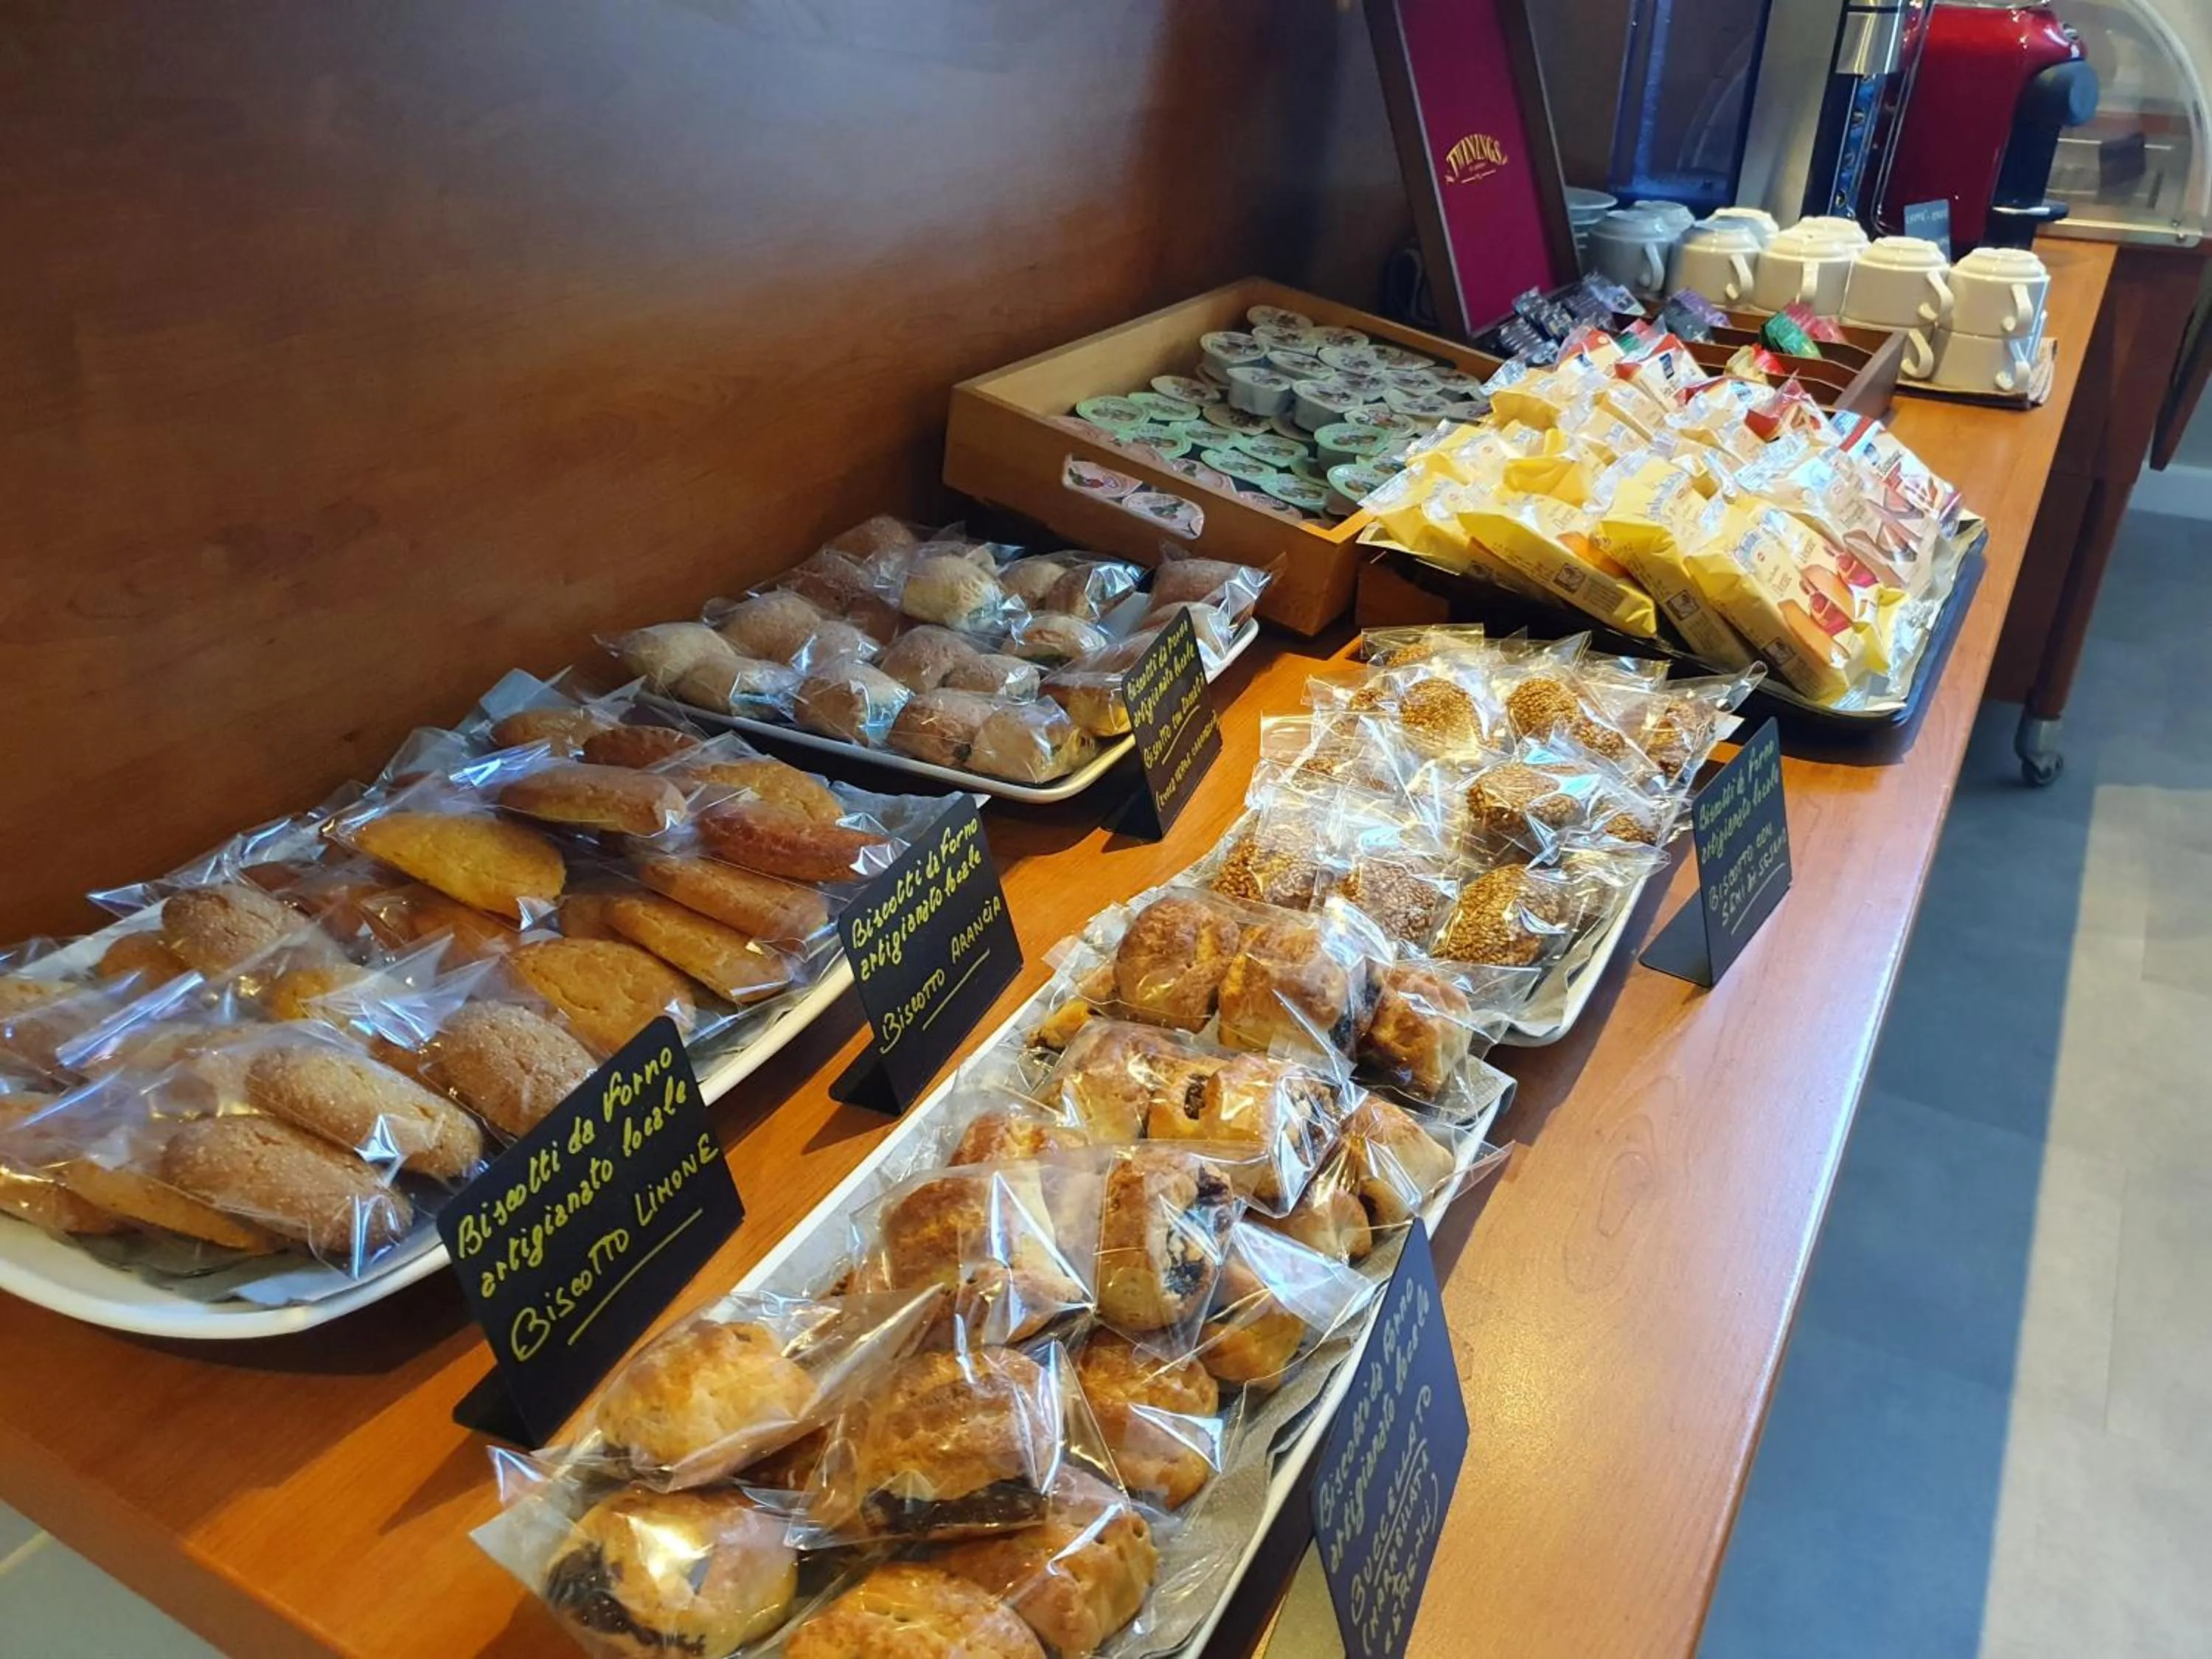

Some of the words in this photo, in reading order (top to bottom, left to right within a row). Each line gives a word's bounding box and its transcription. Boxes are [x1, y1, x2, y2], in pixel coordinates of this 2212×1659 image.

[1446, 133, 1508, 178] TWININGS
[1699, 783, 1734, 831] Biscotti
[852, 860, 922, 950] Biscotti
[926, 850, 940, 880] da
[860, 890, 943, 982] artigianato
[945, 844, 981, 896] locale
[458, 1140, 560, 1259] Biscotti
[568, 1116, 595, 1155] da
[481, 1157, 613, 1298] artigianato
[623, 1076, 687, 1157] locale
[1318, 1381, 1372, 1530] Biscotti
[1369, 1360, 1384, 1402] da
[1329, 1394, 1396, 1576] artigianato
[1394, 1282, 1430, 1394] locale
[1351, 1384, 1432, 1626] BUCCELLATO
